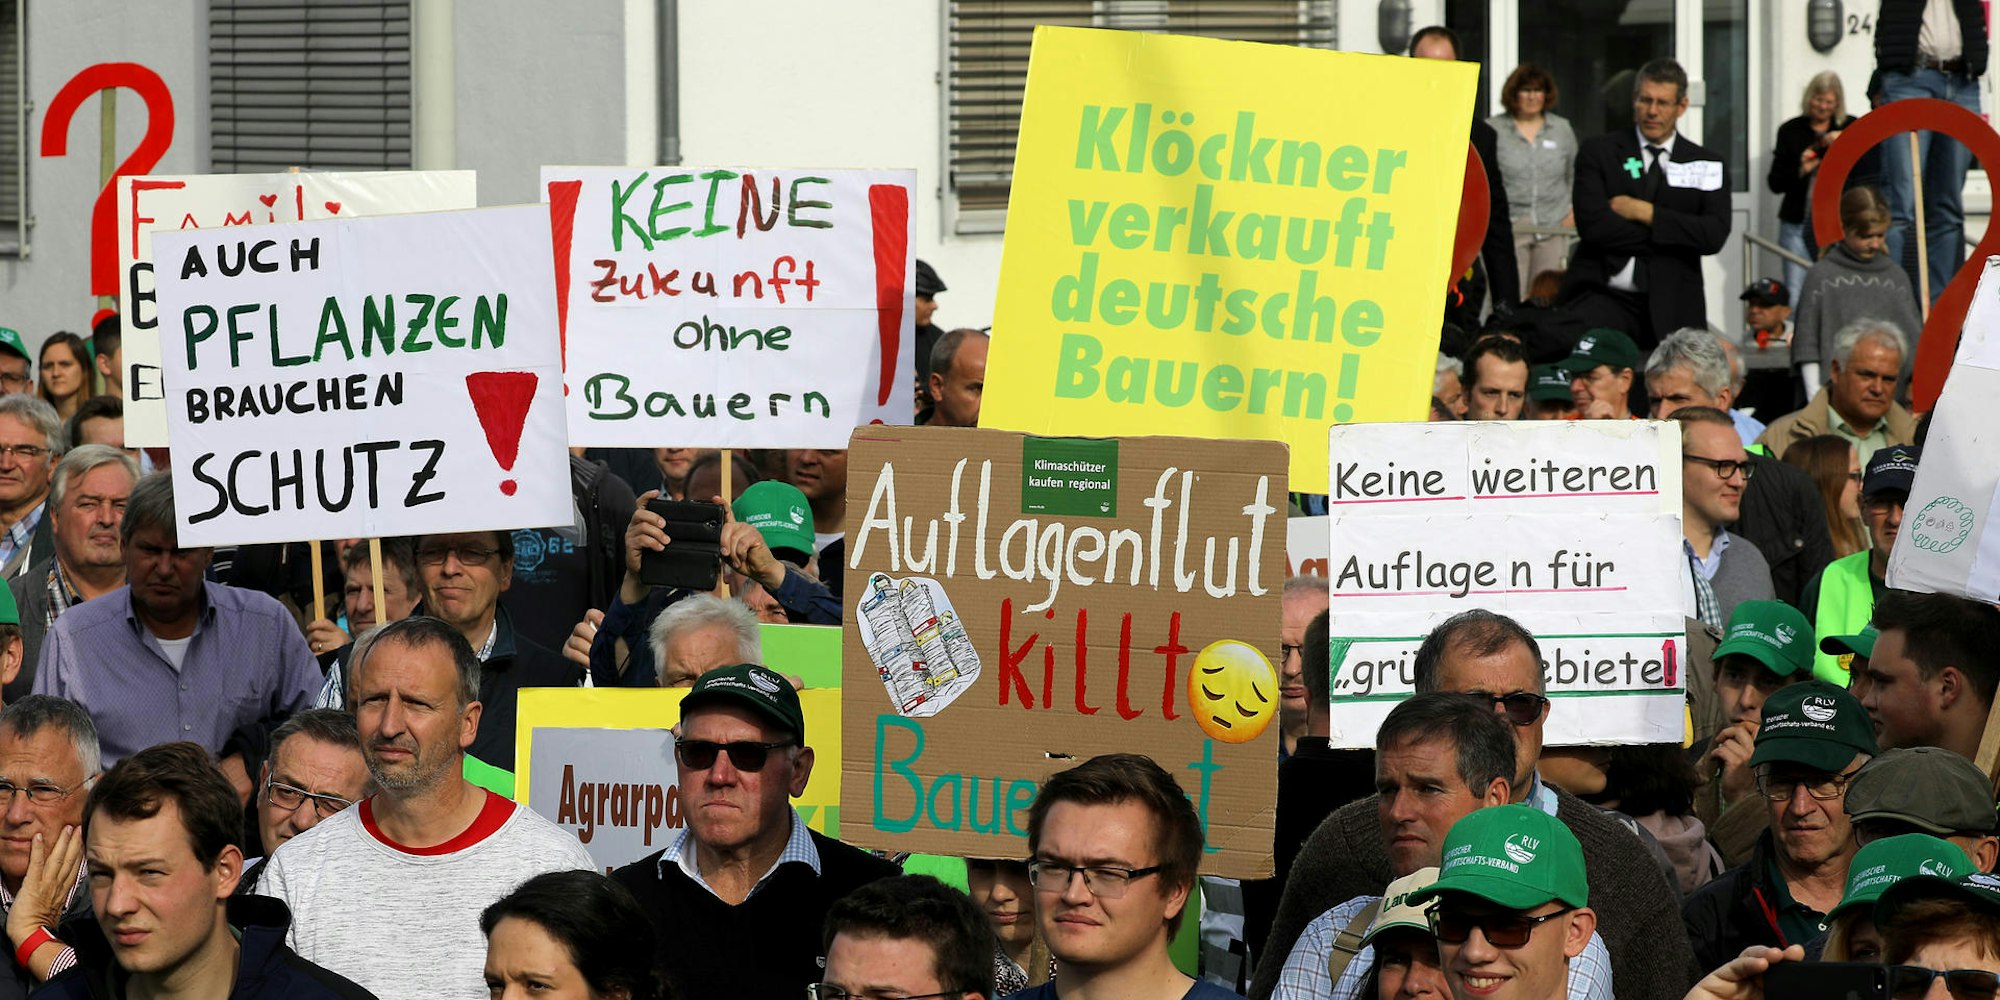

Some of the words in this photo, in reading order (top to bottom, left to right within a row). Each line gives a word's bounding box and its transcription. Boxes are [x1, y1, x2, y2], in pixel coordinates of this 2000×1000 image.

[1848, 14, 1872, 35] 24
[1075, 103, 1408, 194] Klöckner
[611, 171, 834, 251] KEINE
[1068, 184, 1395, 270] verkauft
[180, 237, 320, 280] AUCH
[591, 255, 820, 304] Zukunft
[1051, 252, 1384, 347] deutsche
[183, 293, 508, 370] PFLANZEN
[673, 314, 792, 351] ohne
[187, 371, 403, 424] BRAUCHEN
[584, 372, 830, 420] Bauern
[1054, 333, 1360, 423] Bauern!
[188, 439, 446, 524] SCHUTZ
[1028, 476, 1064, 488] kaufen
[1068, 478, 1111, 491] regional
[1034, 459, 1106, 473] Klimaschützer
[1336, 461, 1446, 499] Keine
[1472, 458, 1657, 495] weiteren
[849, 458, 1277, 614] Auflagenflut
[1548, 549, 1615, 590] für
[998, 597, 1189, 721] killt
[1543, 645, 1675, 687] ebiete!
[1814, 696, 1836, 706] RLV
[557, 764, 684, 847] Agrarpa
[1521, 834, 1540, 851] RLV
[1935, 861, 1953, 878] RLV
